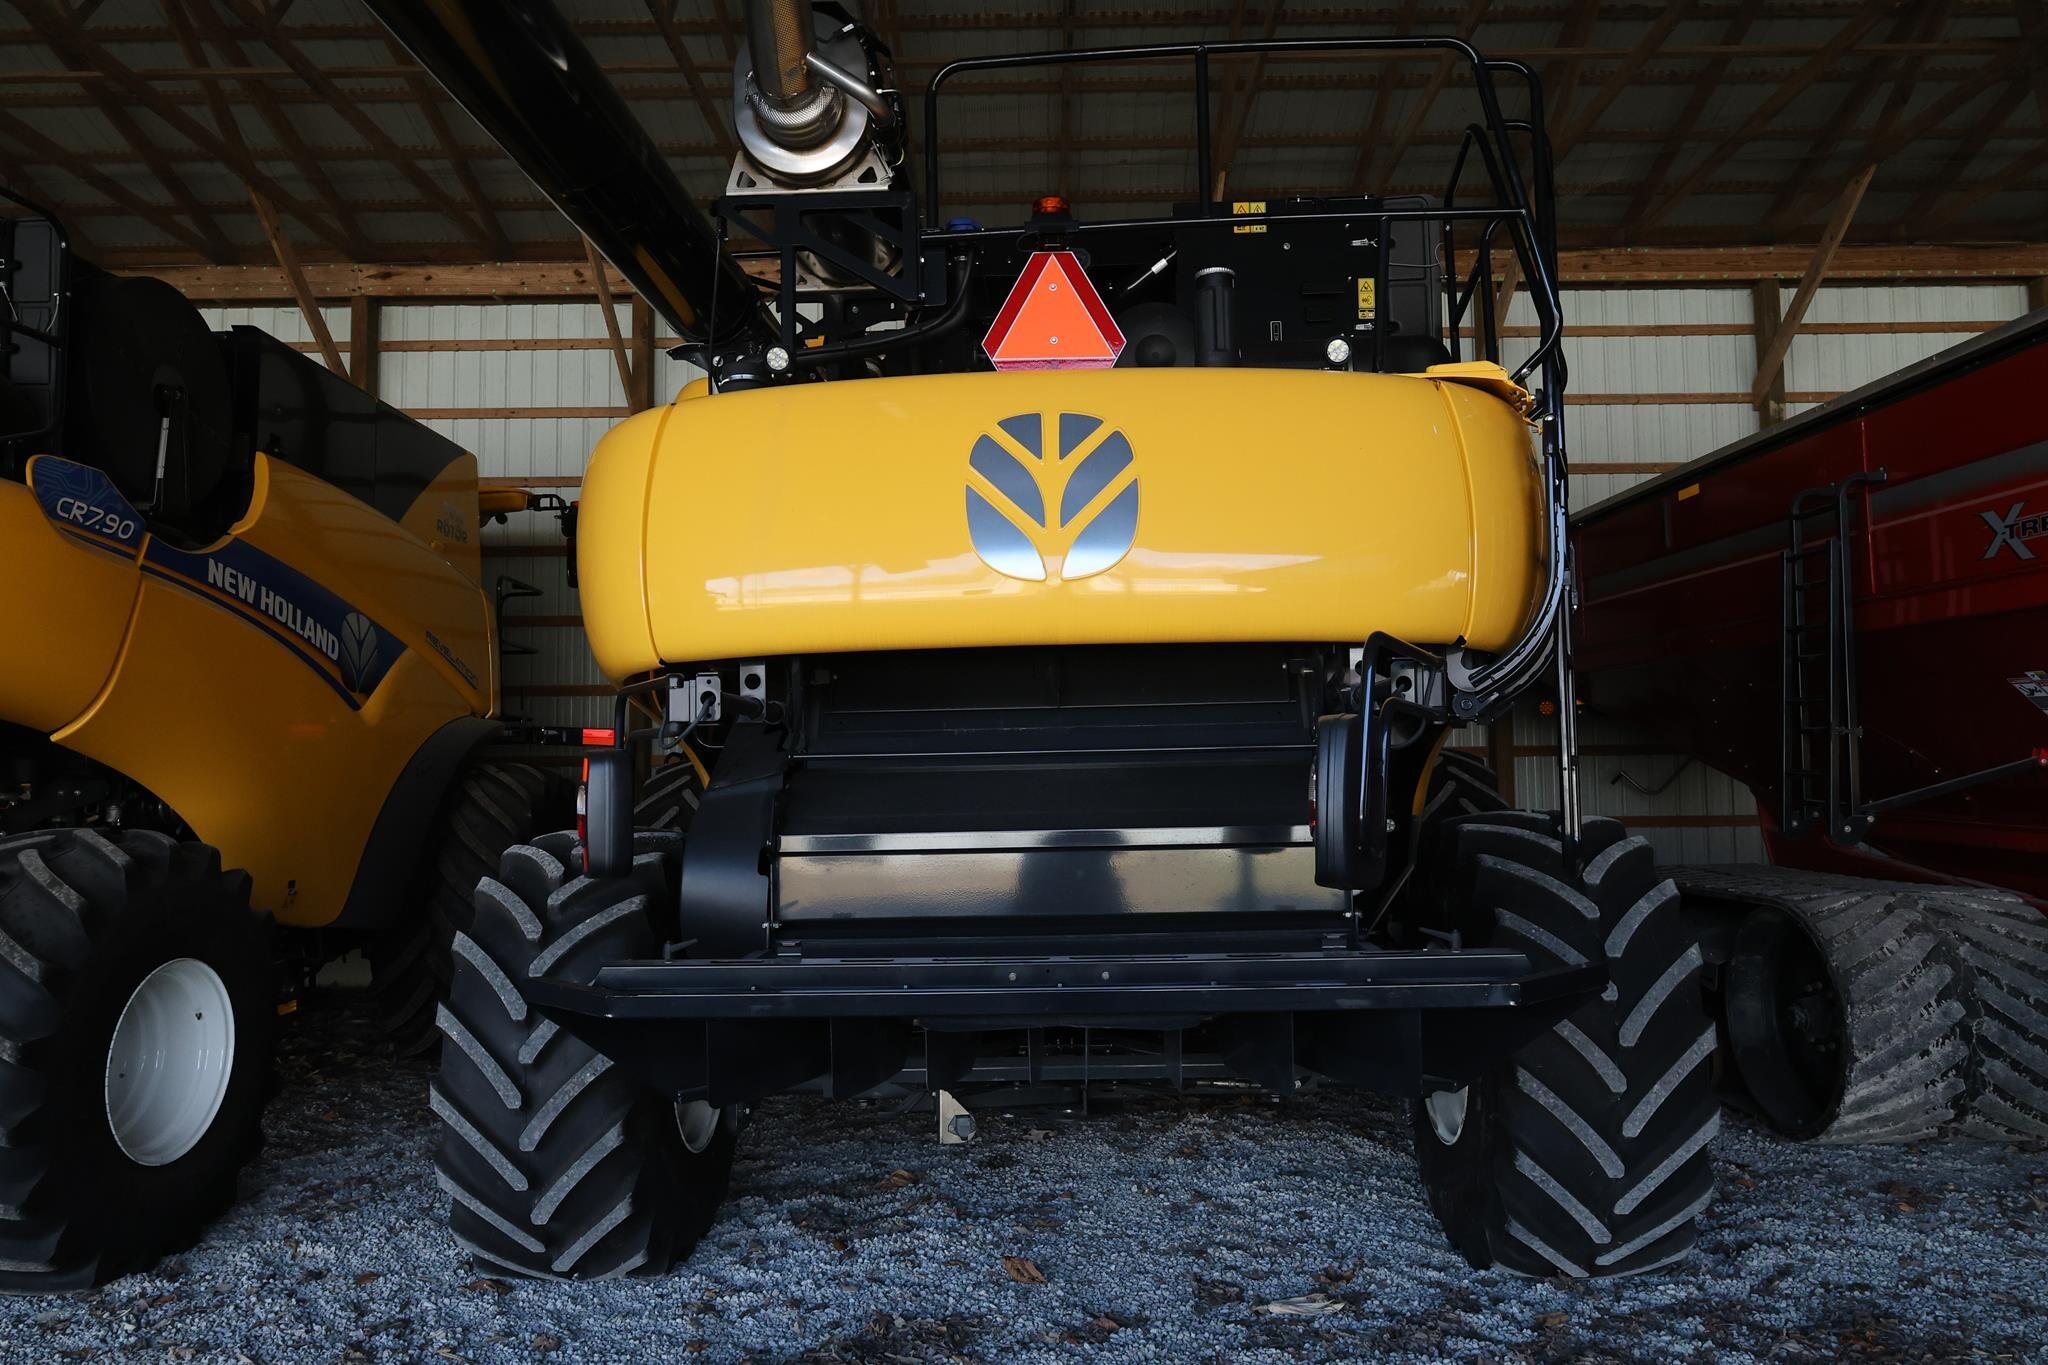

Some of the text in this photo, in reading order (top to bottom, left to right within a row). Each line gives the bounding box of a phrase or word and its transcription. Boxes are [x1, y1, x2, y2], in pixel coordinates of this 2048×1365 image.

[56, 497, 135, 539] CR7.90
[208, 558, 339, 661] NEW HOLLAND
